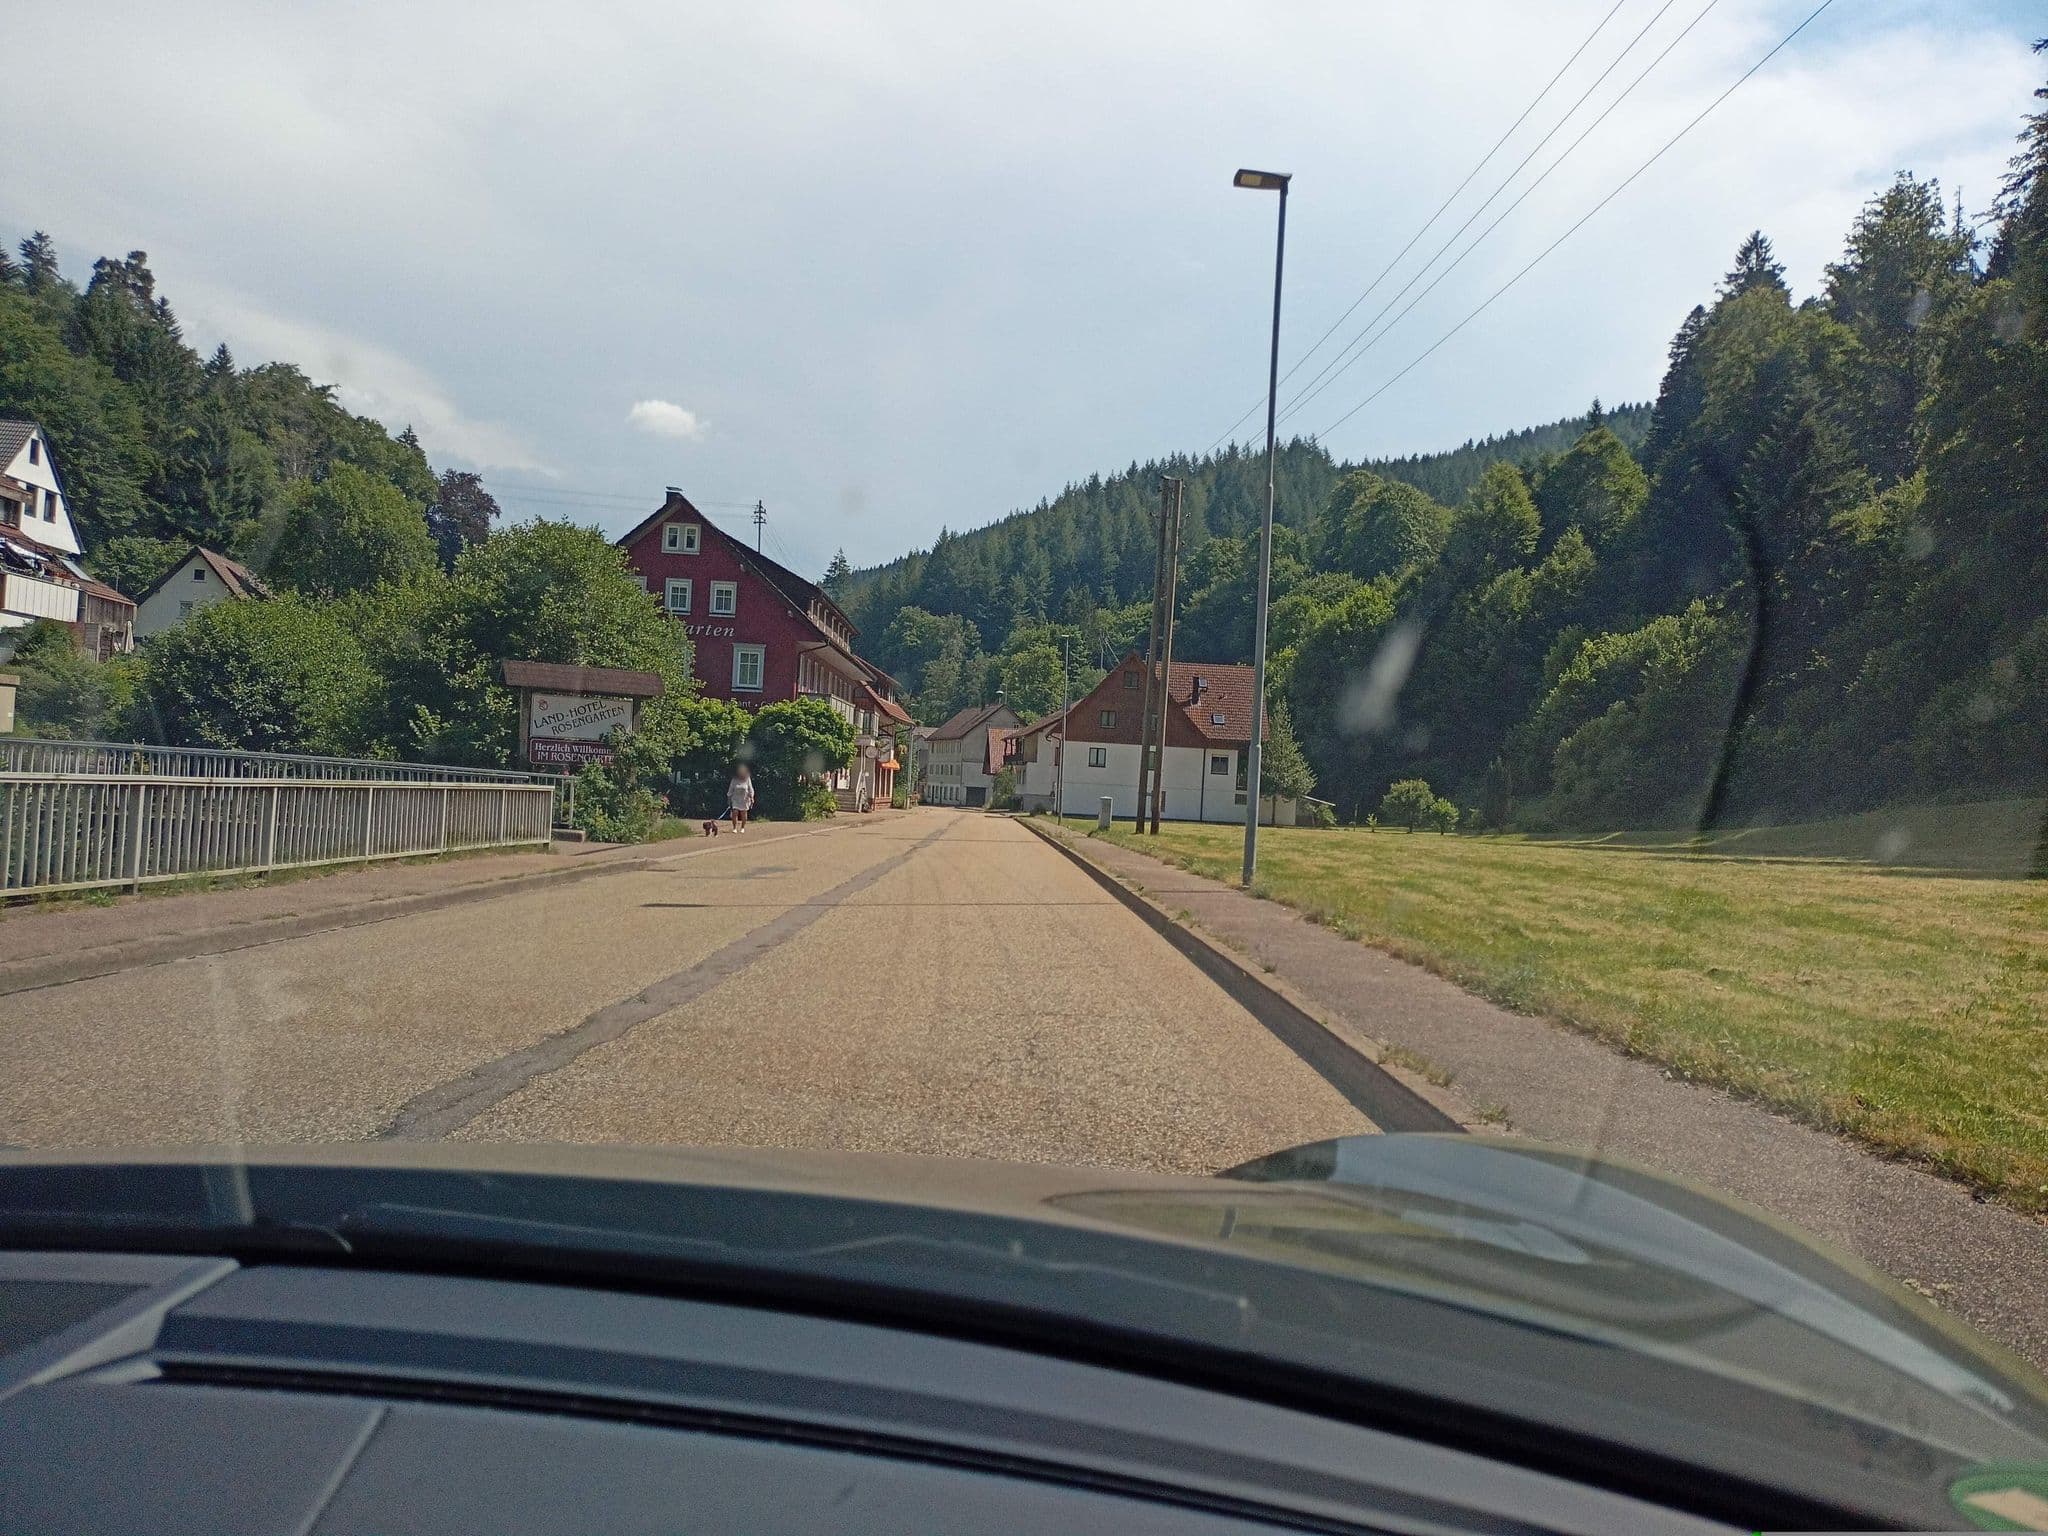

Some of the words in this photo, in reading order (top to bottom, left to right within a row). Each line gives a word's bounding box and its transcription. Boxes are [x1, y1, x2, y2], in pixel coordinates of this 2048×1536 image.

[685, 624, 735, 637] arten
[551, 705, 625, 735] ROSENGARTEN
[535, 743, 570, 752] Herzlich
[571, 744, 613, 754] Willkomm
[537, 751, 548, 761] IM
[551, 752, 615, 764] ROSENGARTE
